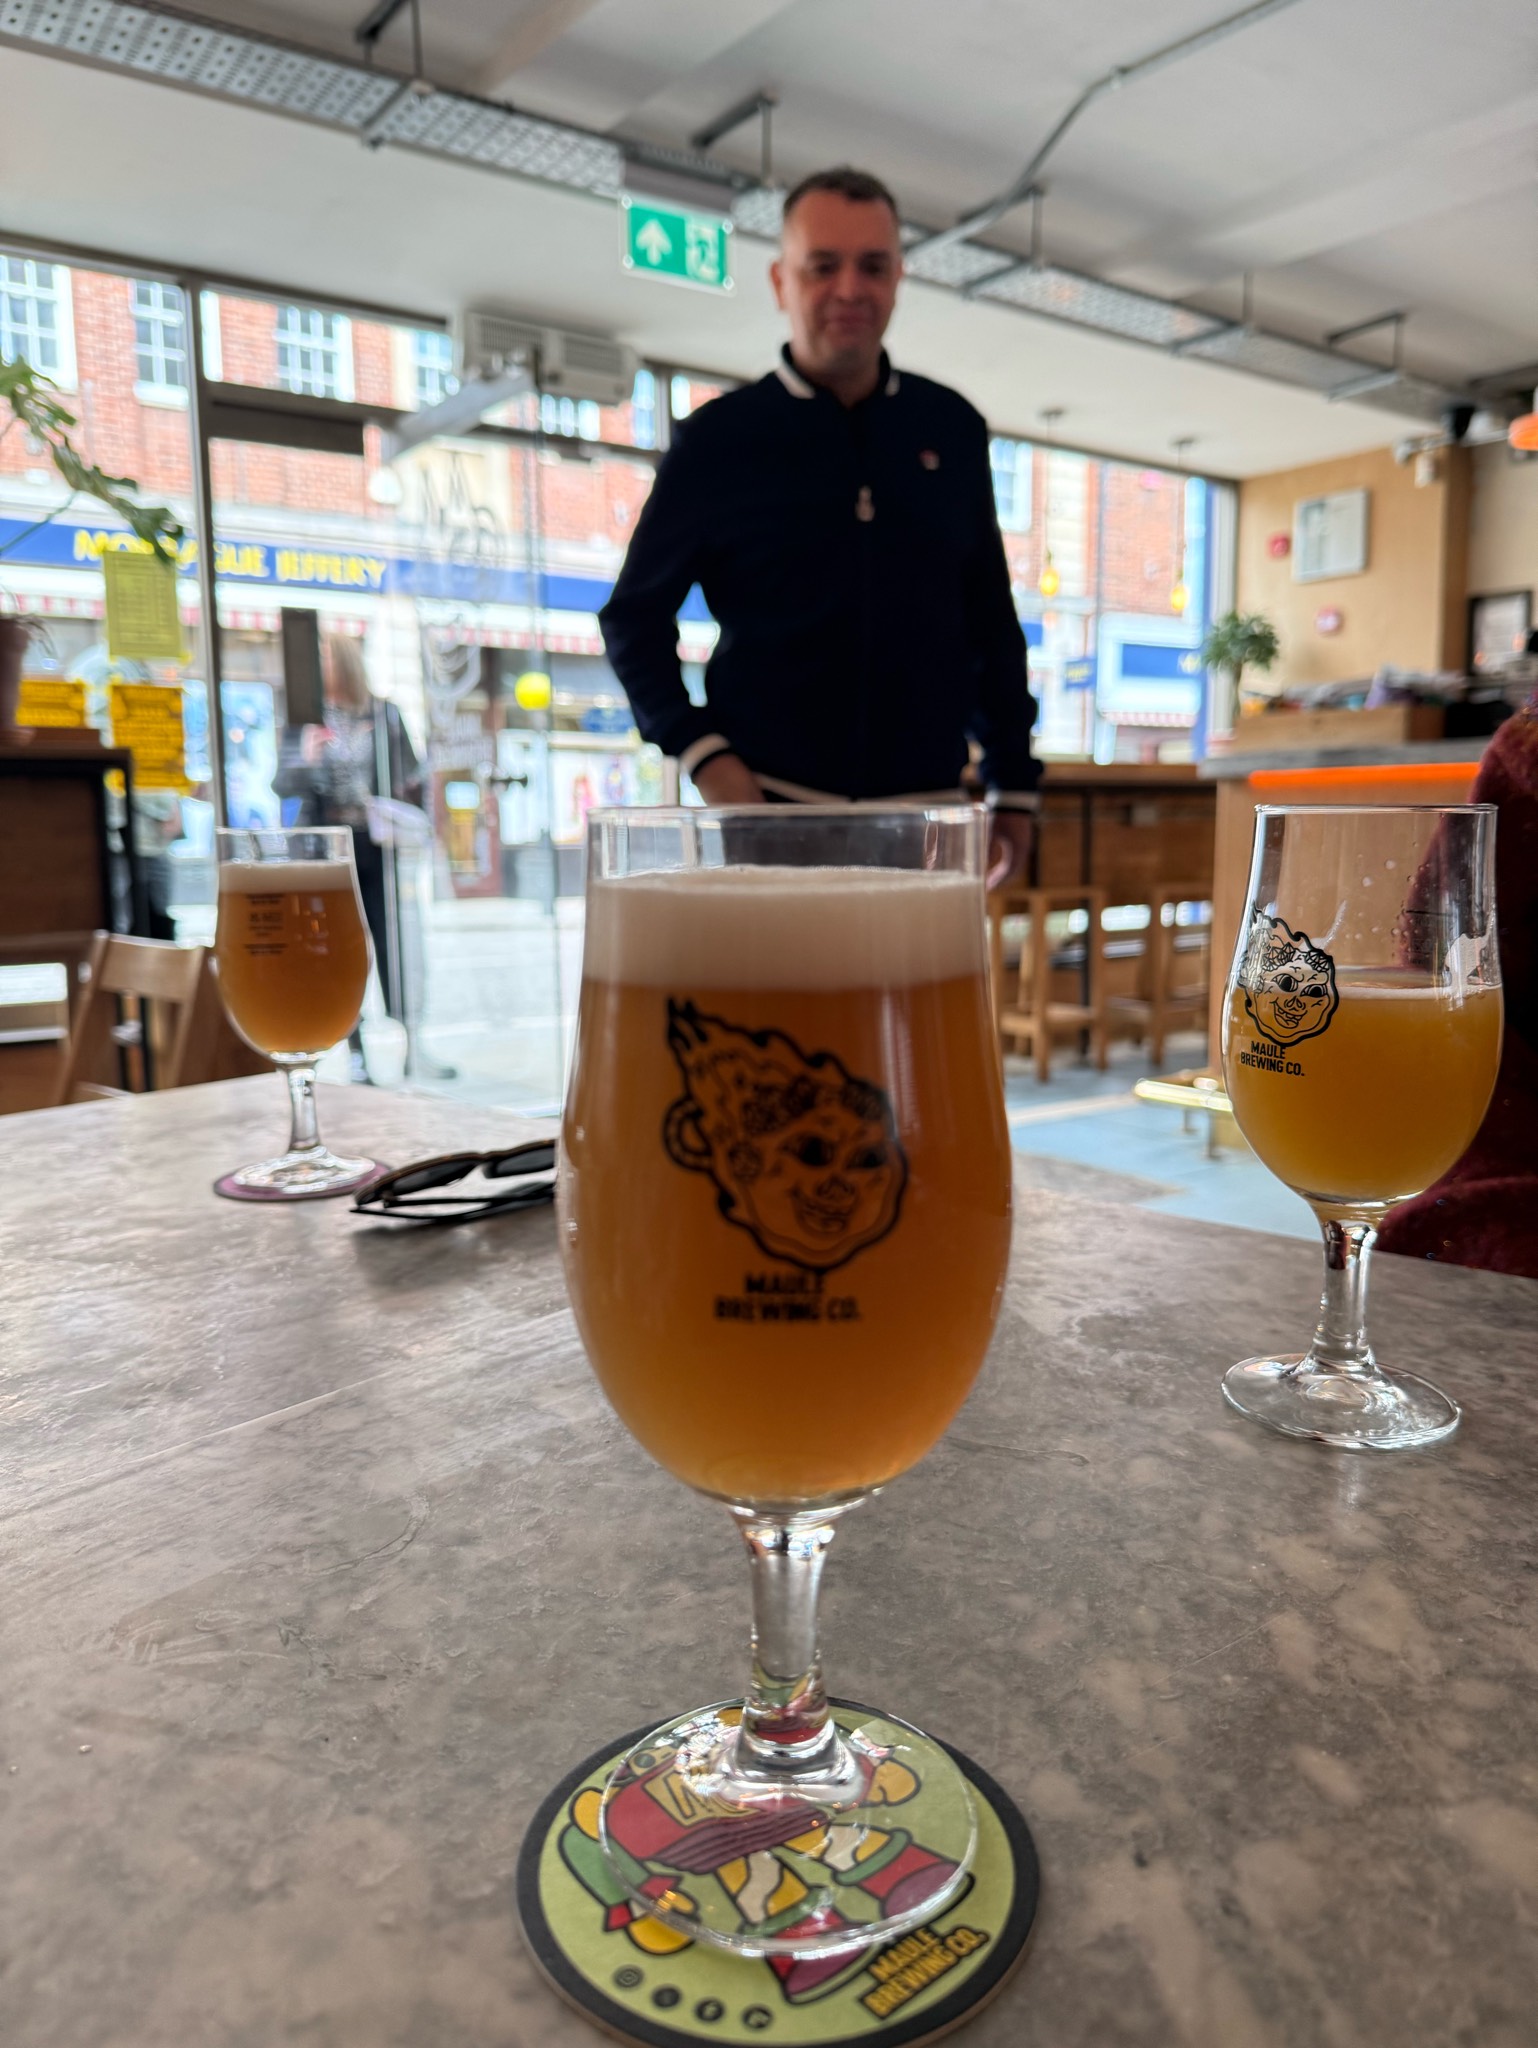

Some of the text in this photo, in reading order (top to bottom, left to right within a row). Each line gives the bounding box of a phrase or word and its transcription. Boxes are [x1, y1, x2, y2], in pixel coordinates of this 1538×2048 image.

[1251, 1041, 1286, 1059] MAULE
[1241, 1052, 1305, 1076] BREWING CO.
[714, 1296, 820, 1321] BREWING
[869, 1927, 940, 1983] MAULE
[863, 1927, 988, 2018] BREWING CO.
